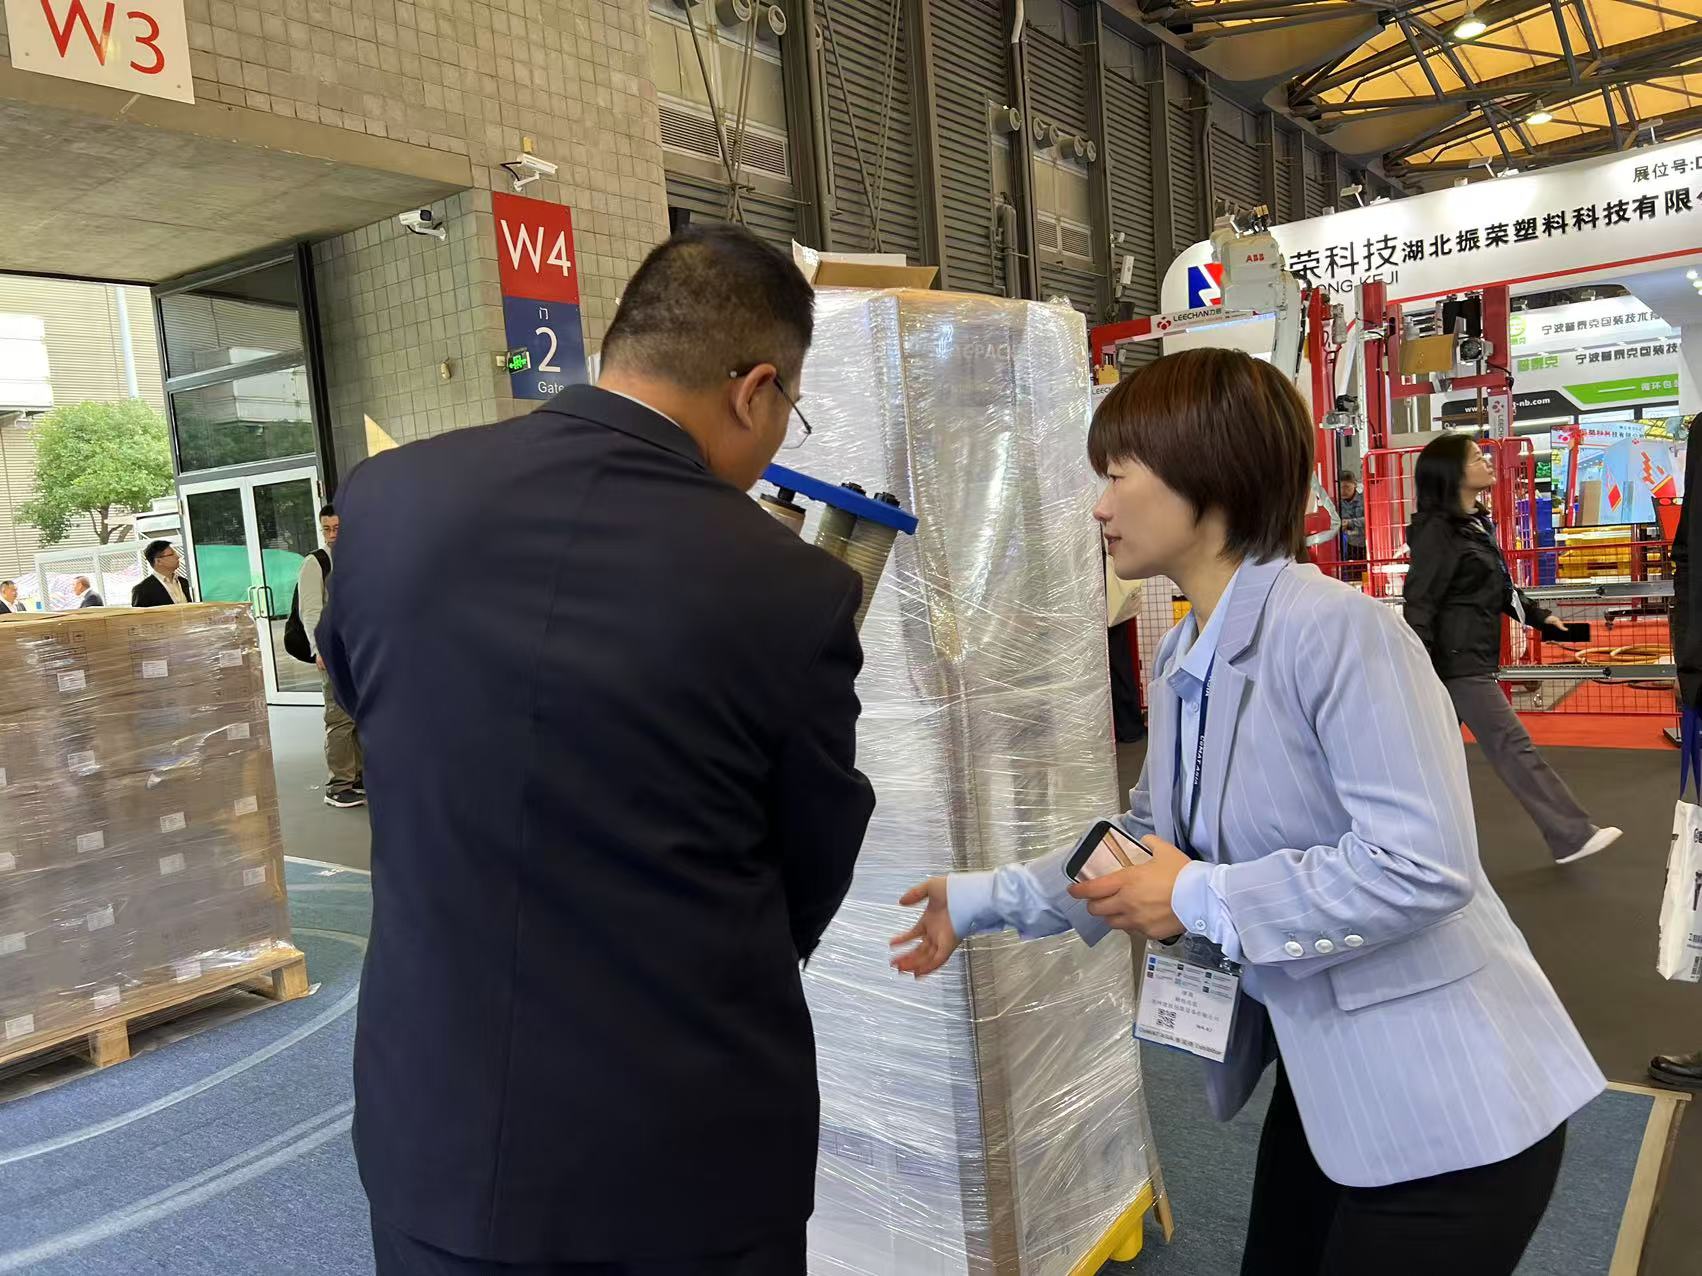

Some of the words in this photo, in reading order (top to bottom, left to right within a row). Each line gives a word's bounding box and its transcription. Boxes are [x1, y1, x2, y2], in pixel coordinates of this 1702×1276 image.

[39, 0, 165, 75] W3
[500, 219, 572, 277] W4
[1246, 253, 1265, 263] ABB
[534, 326, 561, 373] 2
